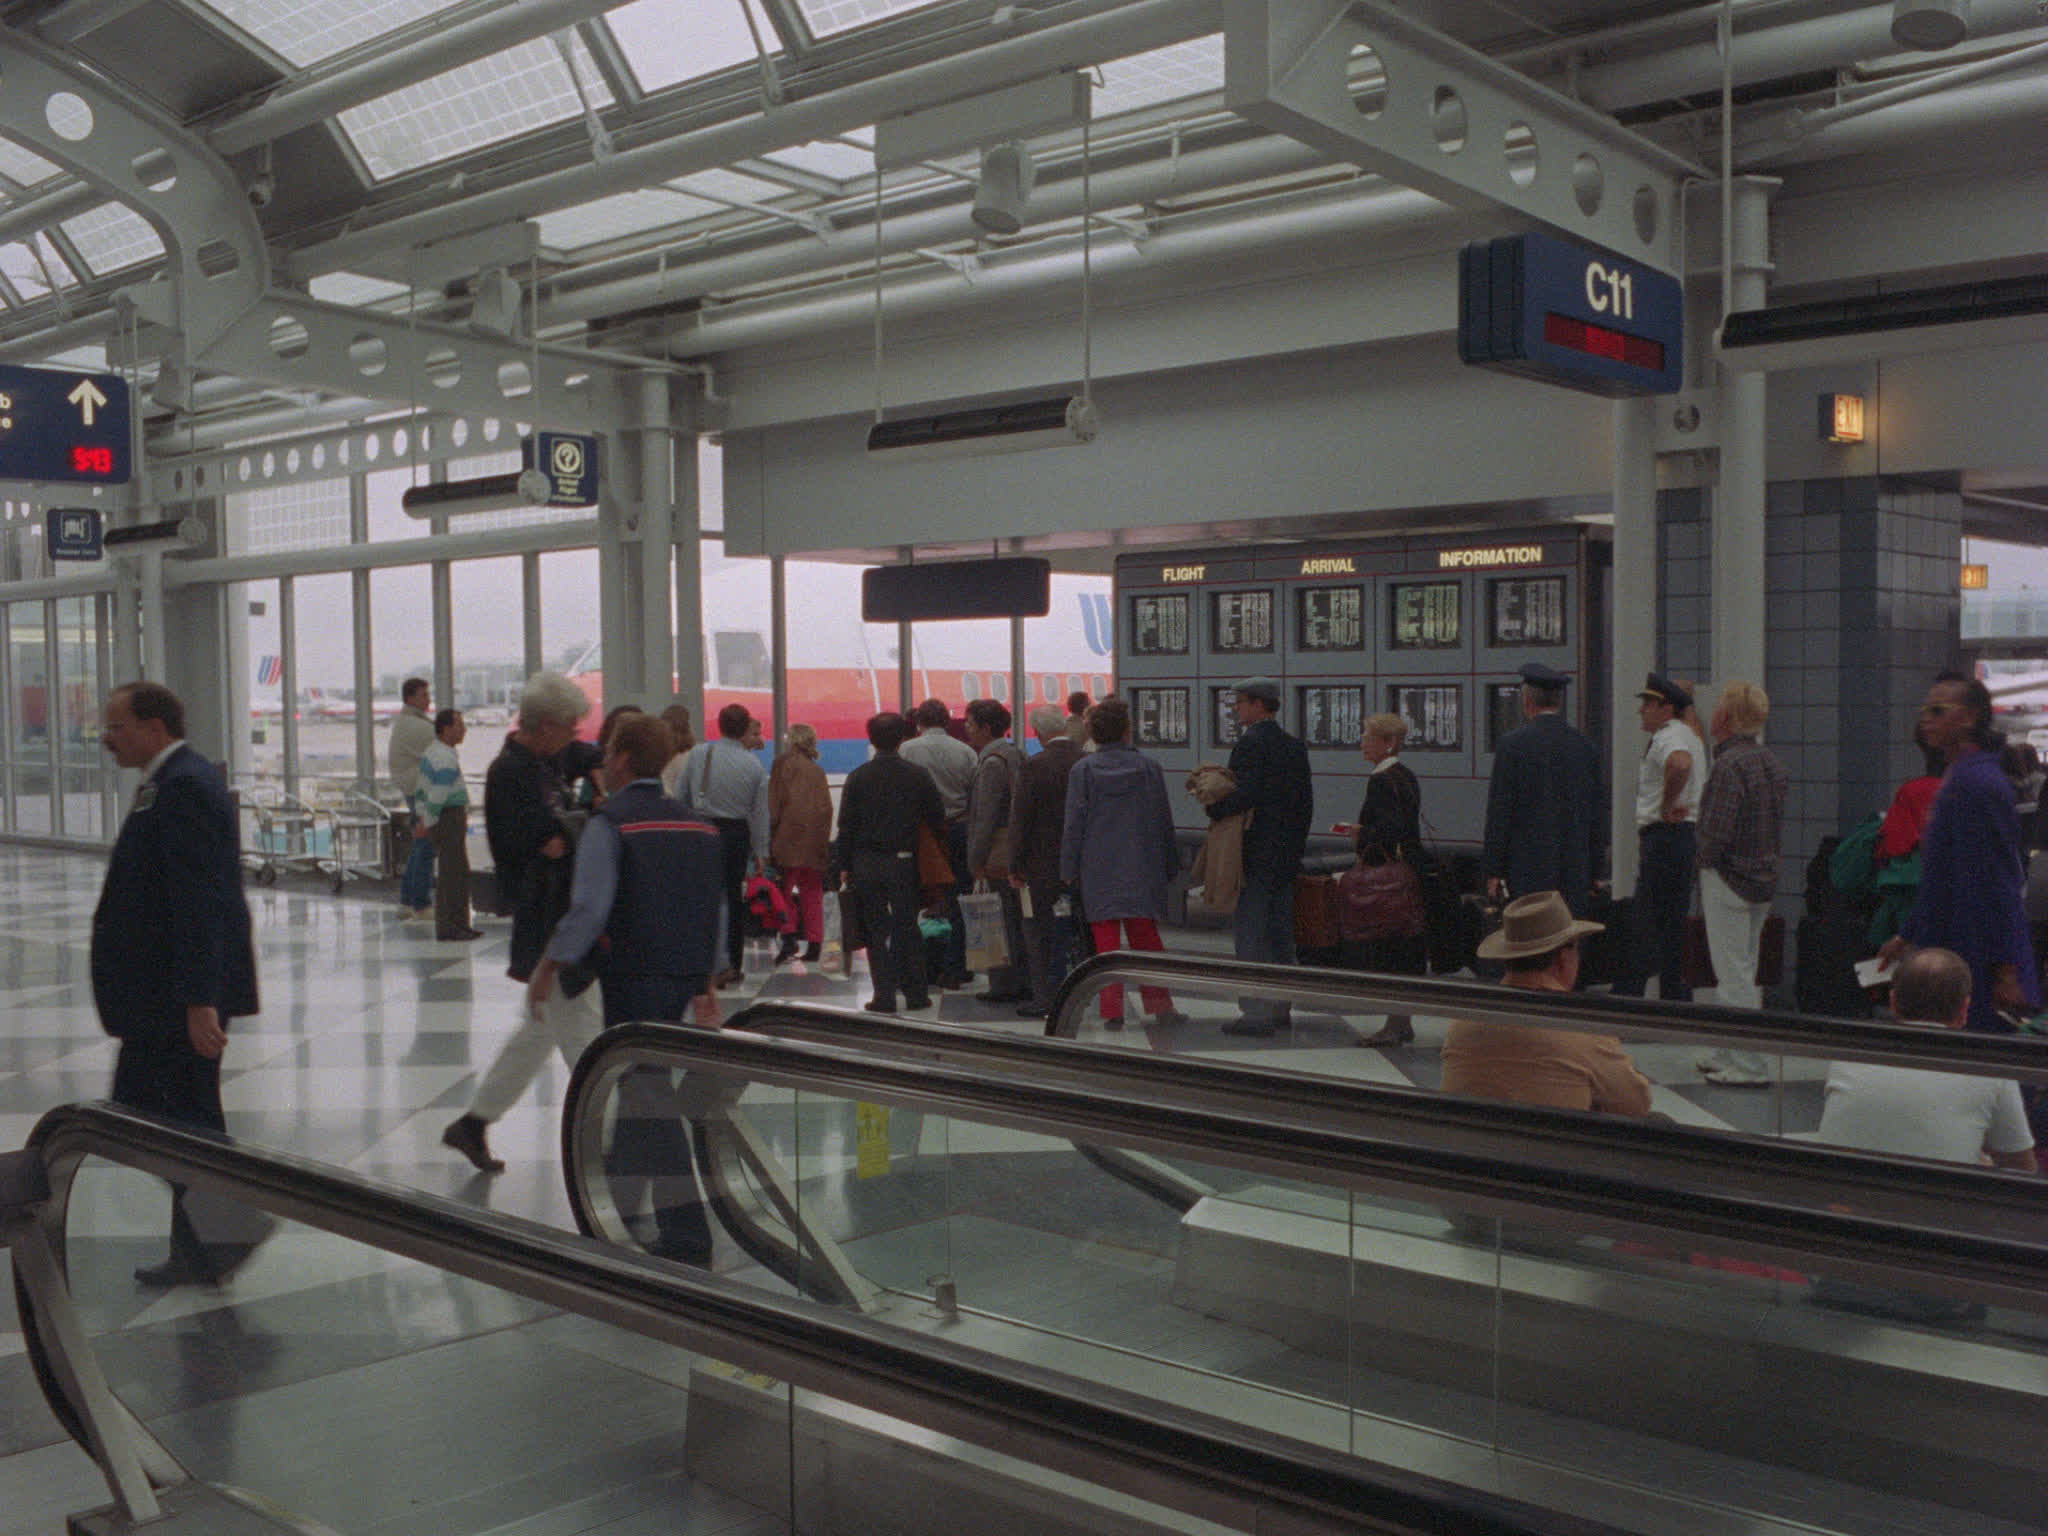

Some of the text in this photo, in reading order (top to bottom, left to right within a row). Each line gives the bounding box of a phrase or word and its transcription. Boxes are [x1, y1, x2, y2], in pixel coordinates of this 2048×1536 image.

[1586, 261, 1633, 319] C11
[1162, 546, 1543, 582] FLIGHT ARRIVAL INFORMATION
